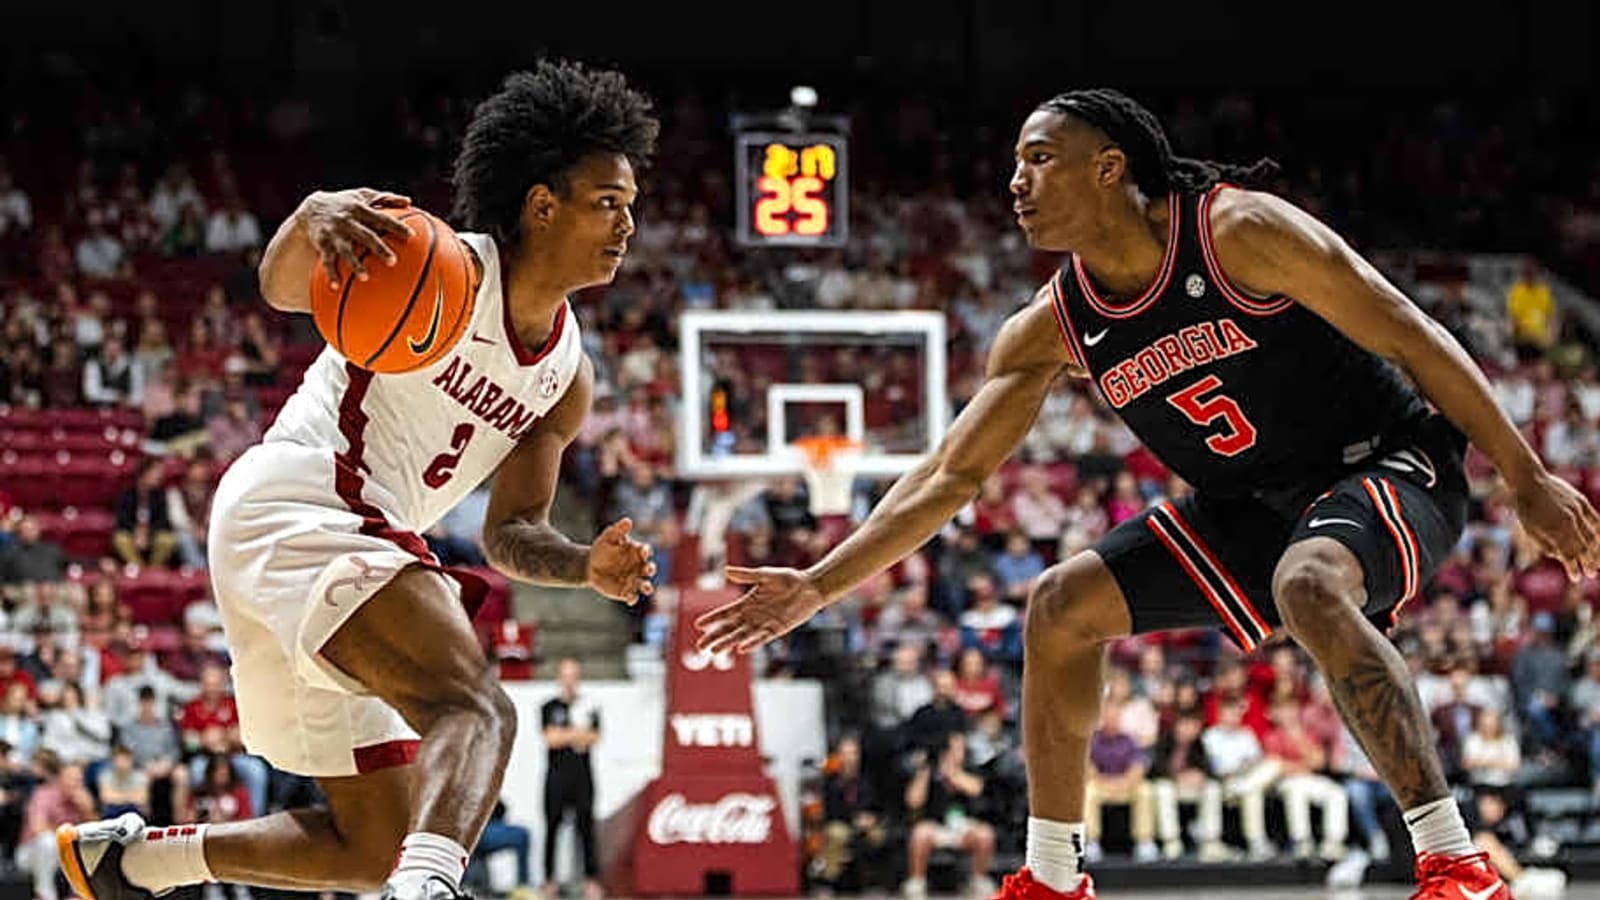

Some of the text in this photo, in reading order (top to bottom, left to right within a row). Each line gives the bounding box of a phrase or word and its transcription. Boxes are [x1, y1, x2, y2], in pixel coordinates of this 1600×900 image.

[754, 176, 828, 236] 25
[432, 355, 541, 440] ALABAM
[1100, 318, 1258, 408] GEORGIA
[1166, 374, 1257, 457] 5
[422, 422, 475, 489] 2
[671, 714, 754, 747] YETI
